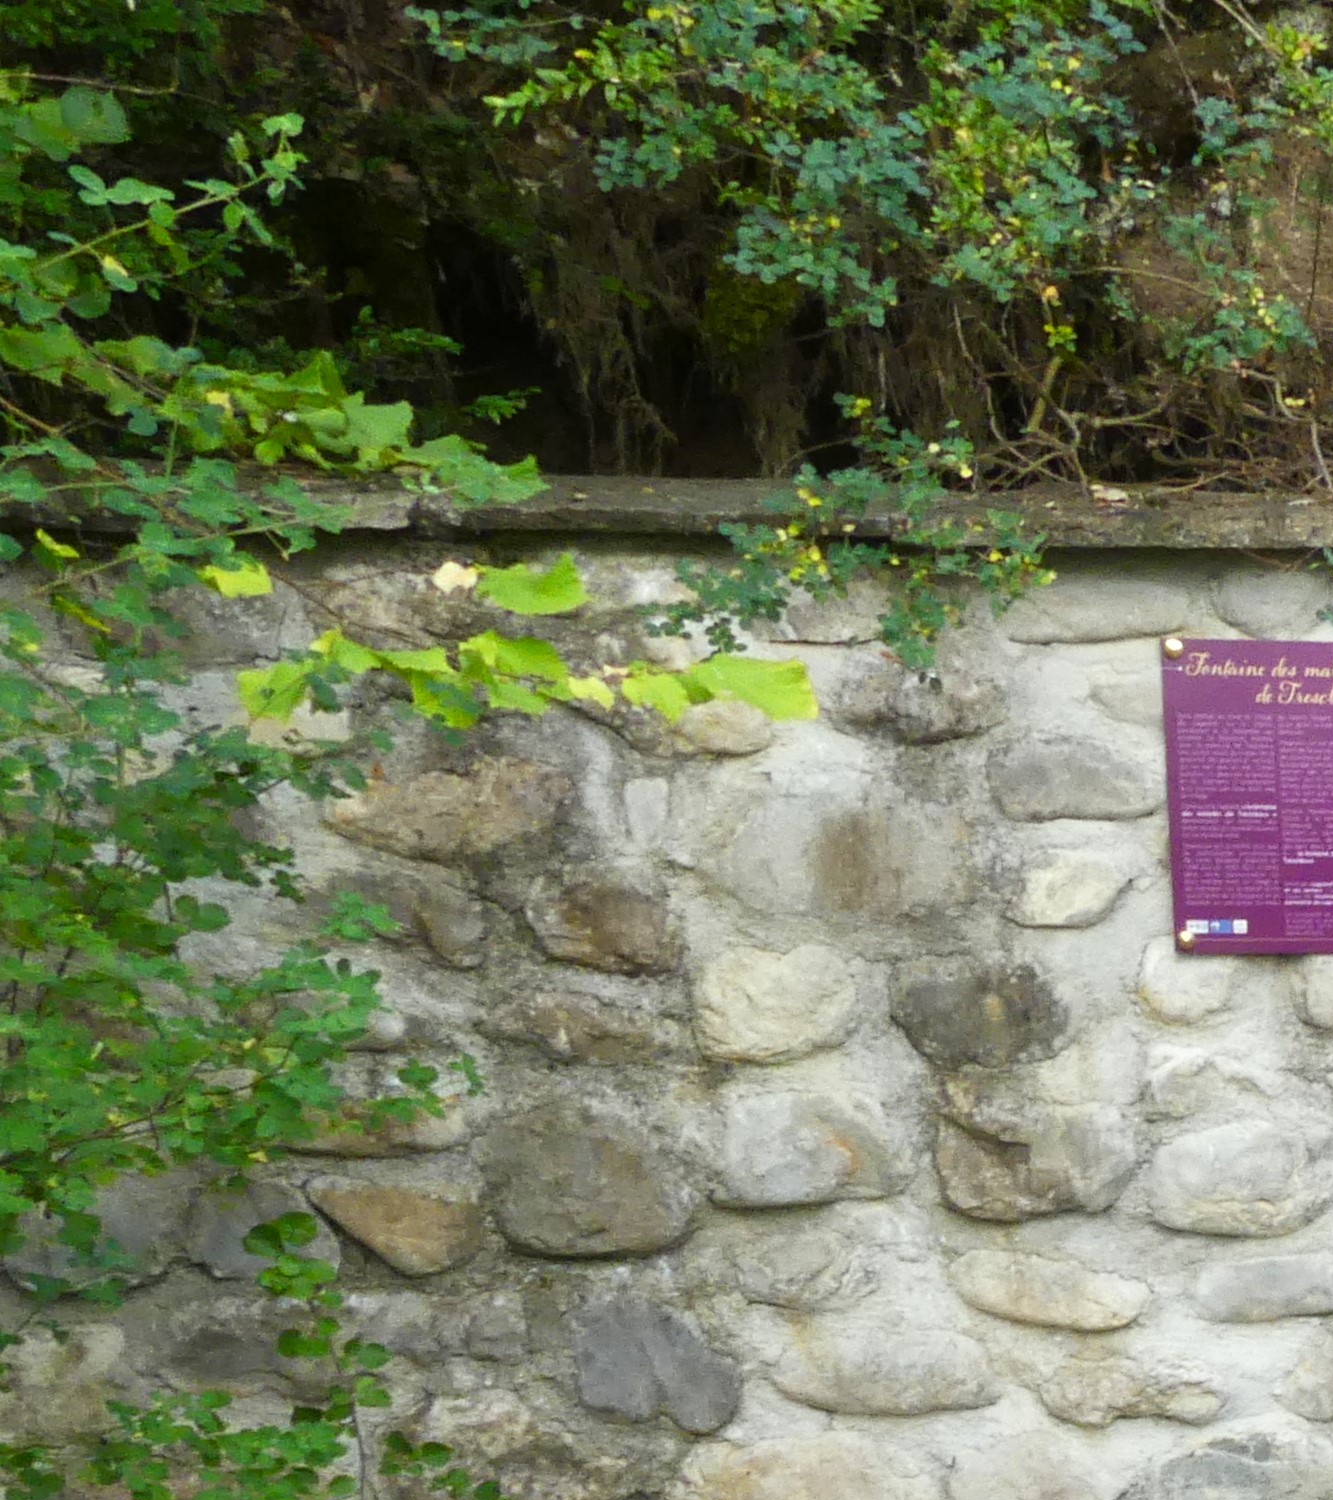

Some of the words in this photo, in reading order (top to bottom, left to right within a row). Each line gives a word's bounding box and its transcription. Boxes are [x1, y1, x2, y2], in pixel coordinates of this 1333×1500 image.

[1185, 651, 1265, 677] Fontaine
[1271, 656, 1297, 677] des
[1255, 682, 1273, 704] de
